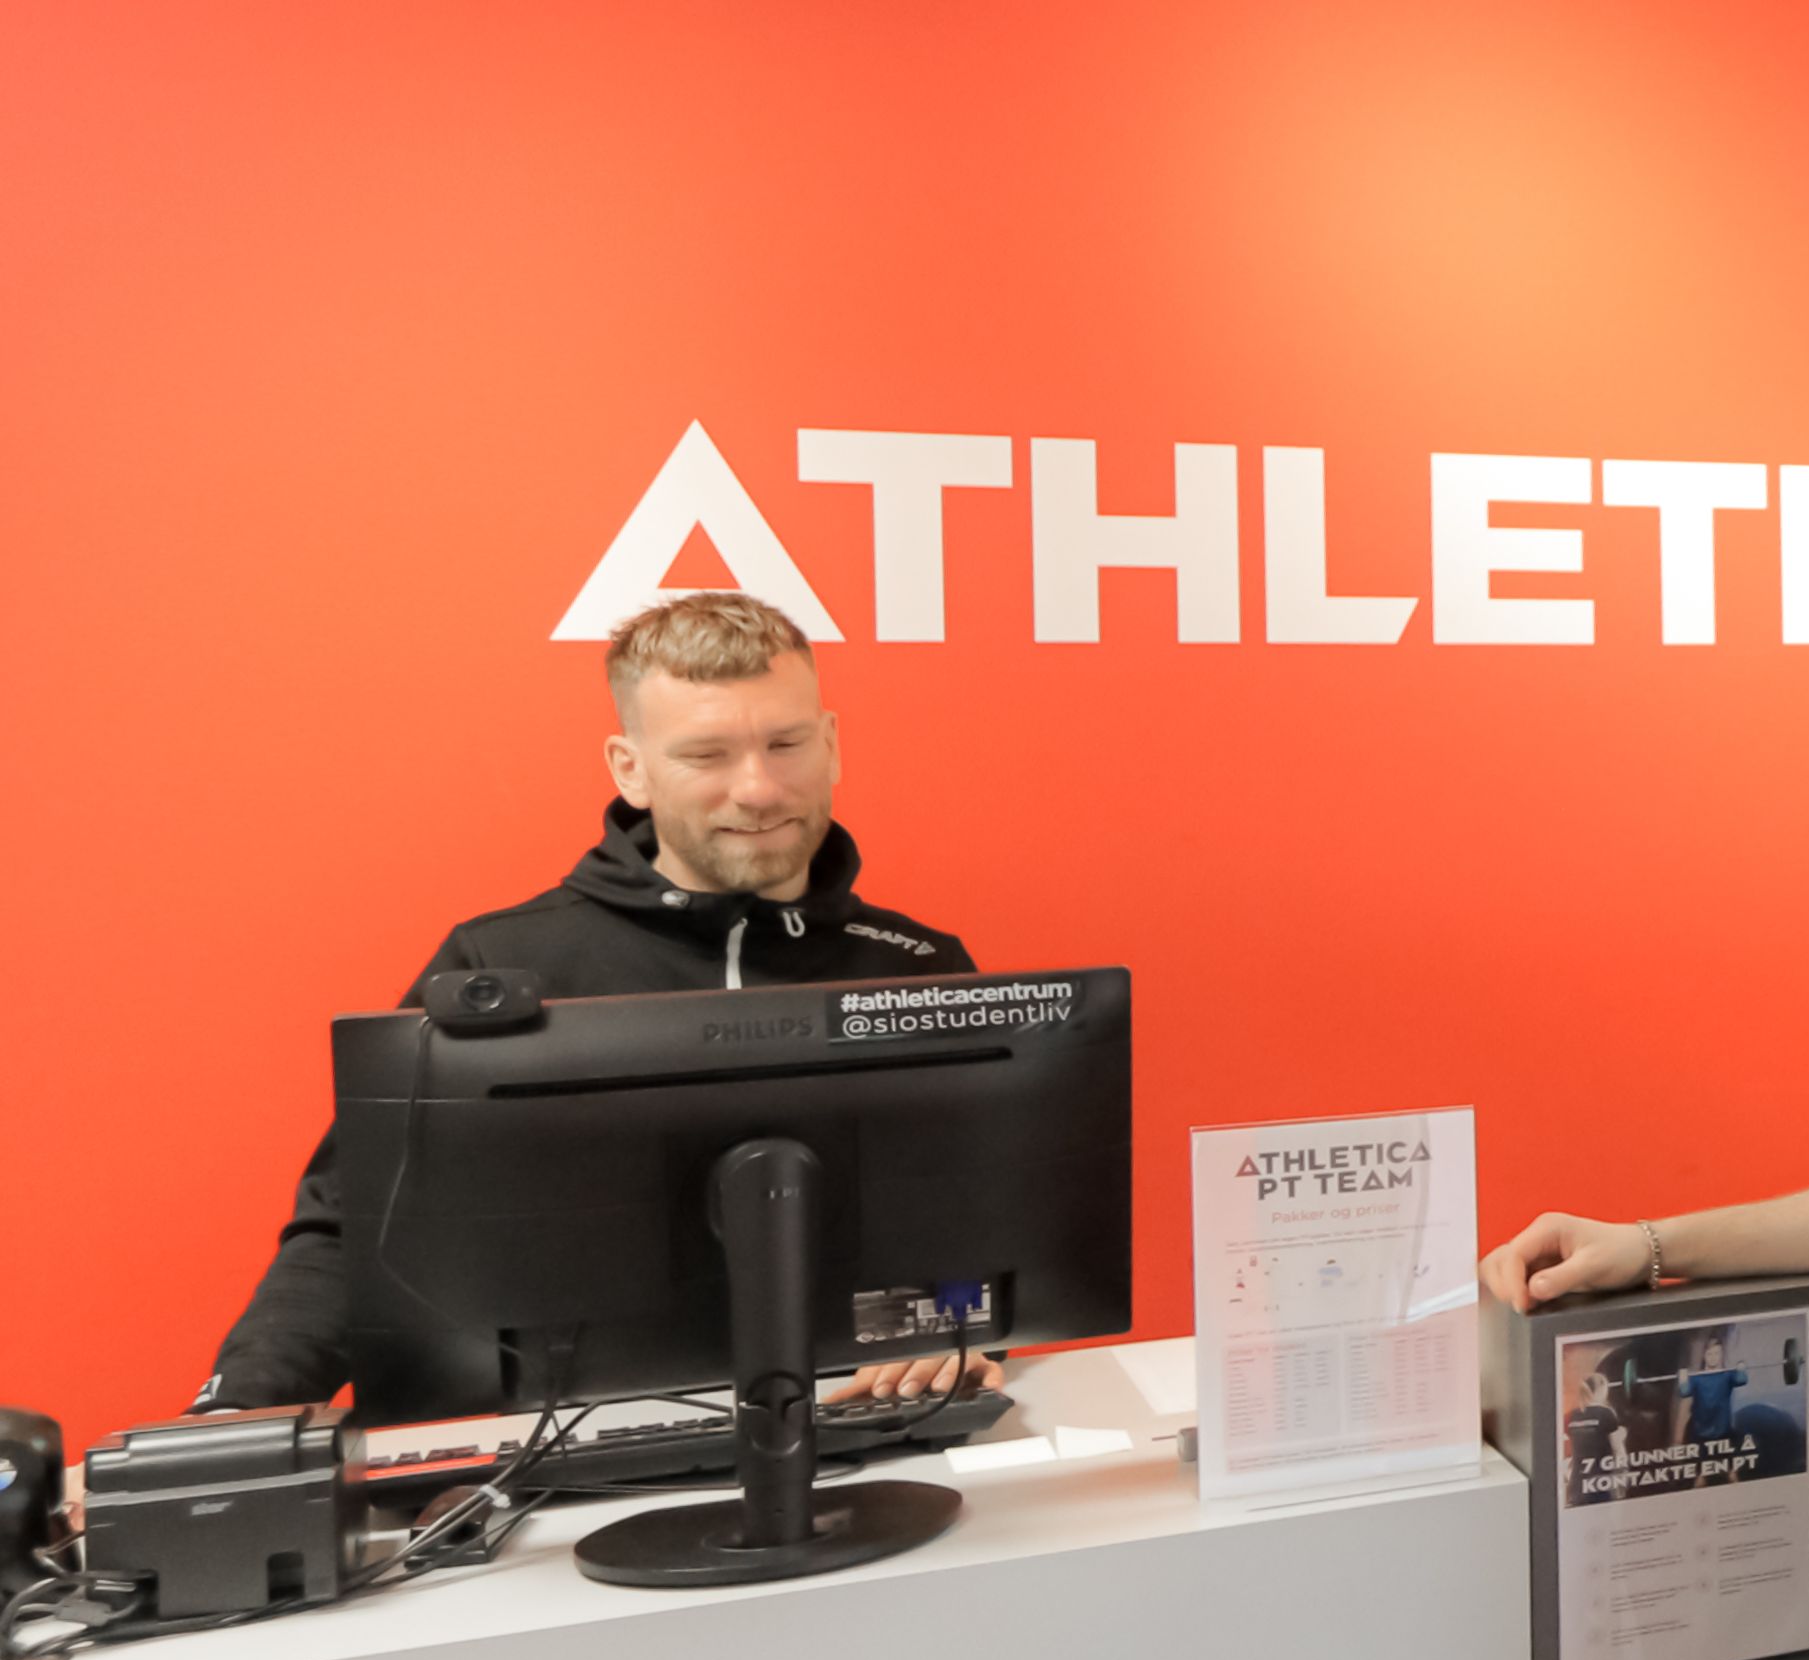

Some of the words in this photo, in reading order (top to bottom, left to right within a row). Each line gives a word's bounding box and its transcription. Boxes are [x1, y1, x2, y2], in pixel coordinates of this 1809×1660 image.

[845, 923, 919, 949] CRAFT
[840, 982, 1072, 1013] #athleticacentrum
[704, 1016, 813, 1042] PHILIPS
[842, 1003, 1072, 1039] @siostudentliv
[1235, 1140, 1432, 1178] ATHLETICA
[1258, 1175, 1301, 1200] PT
[1314, 1167, 1413, 1195] TEAM
[1272, 1209, 1325, 1225] Pakker
[1331, 1206, 1351, 1220] og
[1356, 1202, 1401, 1217] priser
[1581, 1458, 1597, 1474] 7
[1601, 1443, 1700, 1471] GRUNNER
[1704, 1439, 1735, 1456] TIL
[1740, 1433, 1757, 1451] Å
[1582, 1463, 1697, 1494] KONTAKTE
[1702, 1459, 1729, 1477] EN
[1733, 1454, 1759, 1472] PT
